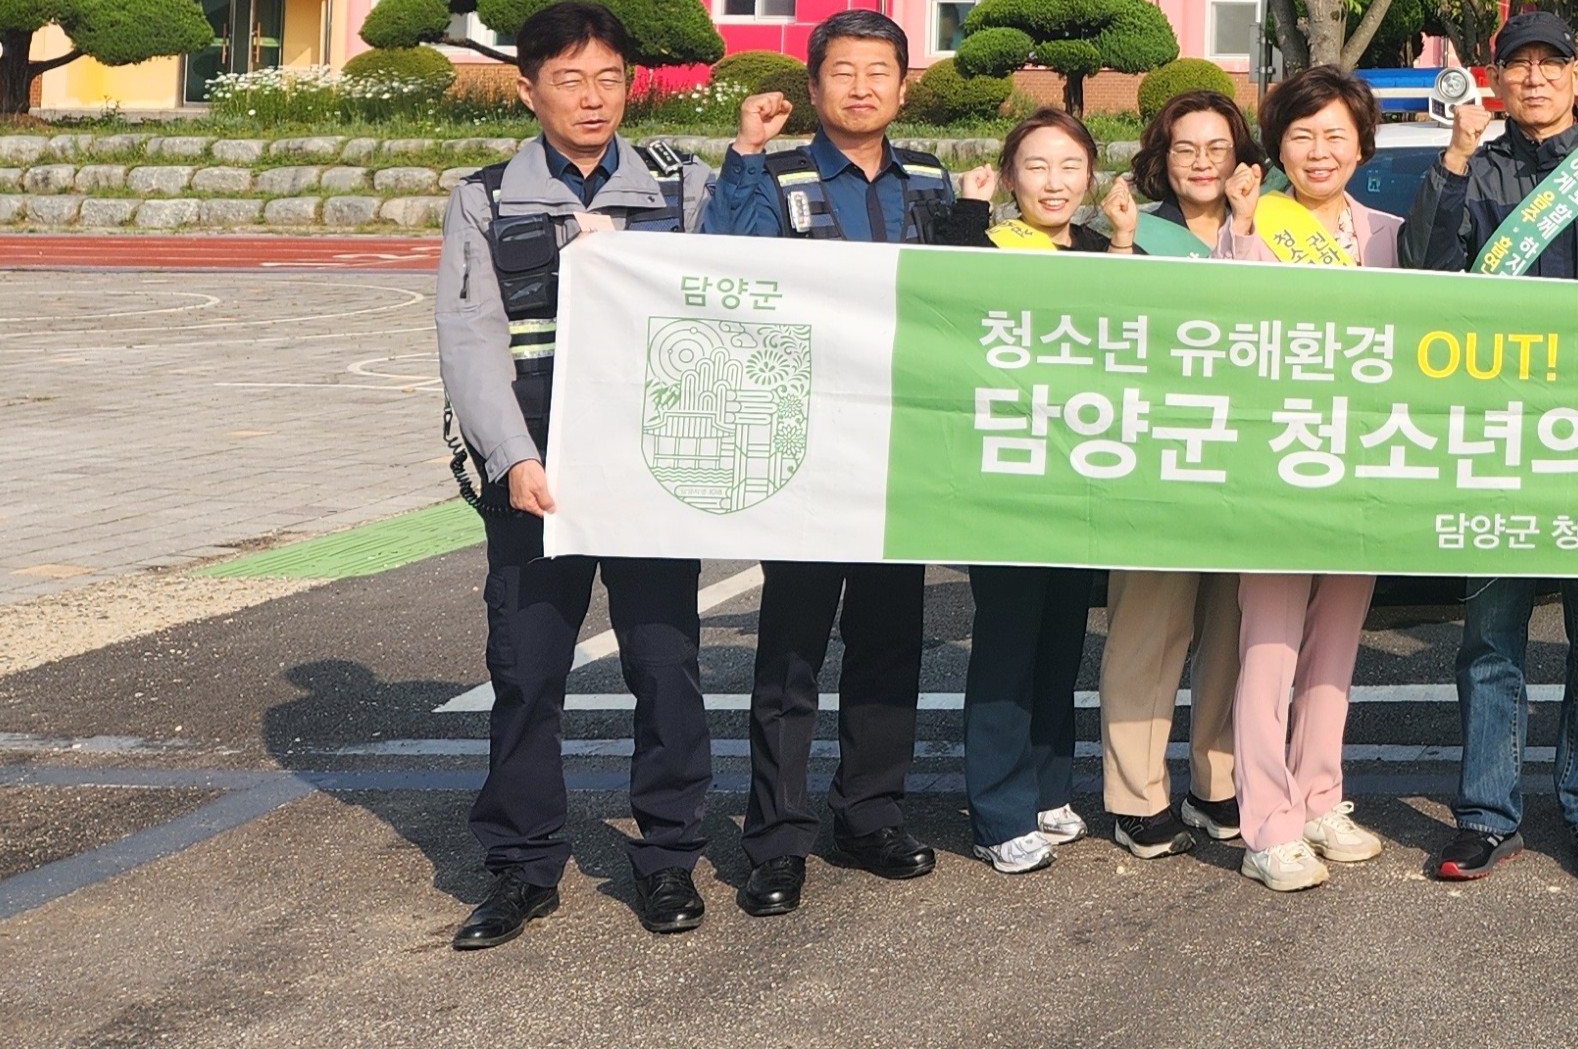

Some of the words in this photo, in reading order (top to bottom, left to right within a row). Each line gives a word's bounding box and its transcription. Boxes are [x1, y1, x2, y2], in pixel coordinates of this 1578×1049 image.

[1537, 203, 1574, 240] 함께
[680, 275, 783, 312] 담양군
[978, 310, 1149, 375] 청소년
[1170, 319, 1396, 385] 유해환경
[1416, 329, 1560, 382] OUT!
[974, 384, 1239, 483] 담양군
[1434, 512, 1542, 550] 담양군
